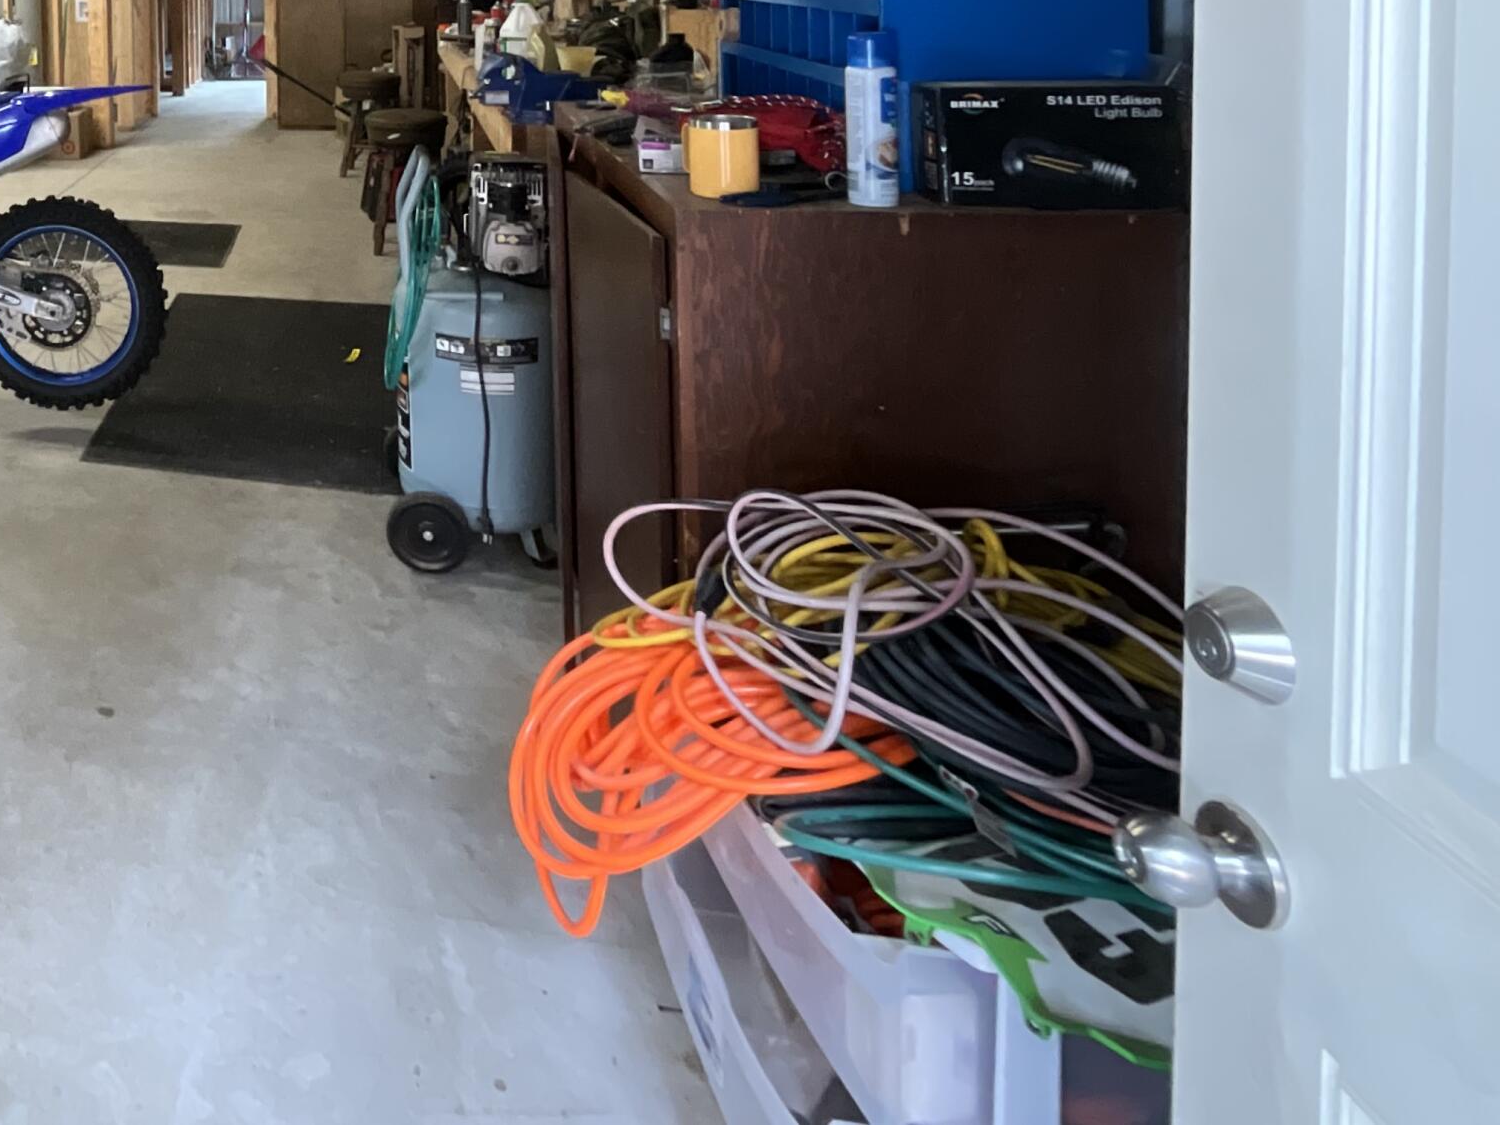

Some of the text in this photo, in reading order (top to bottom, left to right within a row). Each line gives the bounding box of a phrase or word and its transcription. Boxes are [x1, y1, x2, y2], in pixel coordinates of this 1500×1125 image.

[949, 100, 1000, 109] BRIMAX
[1046, 95, 1163, 106] S14 LED Edison
[1094, 107, 1164, 119] Light Bulb
